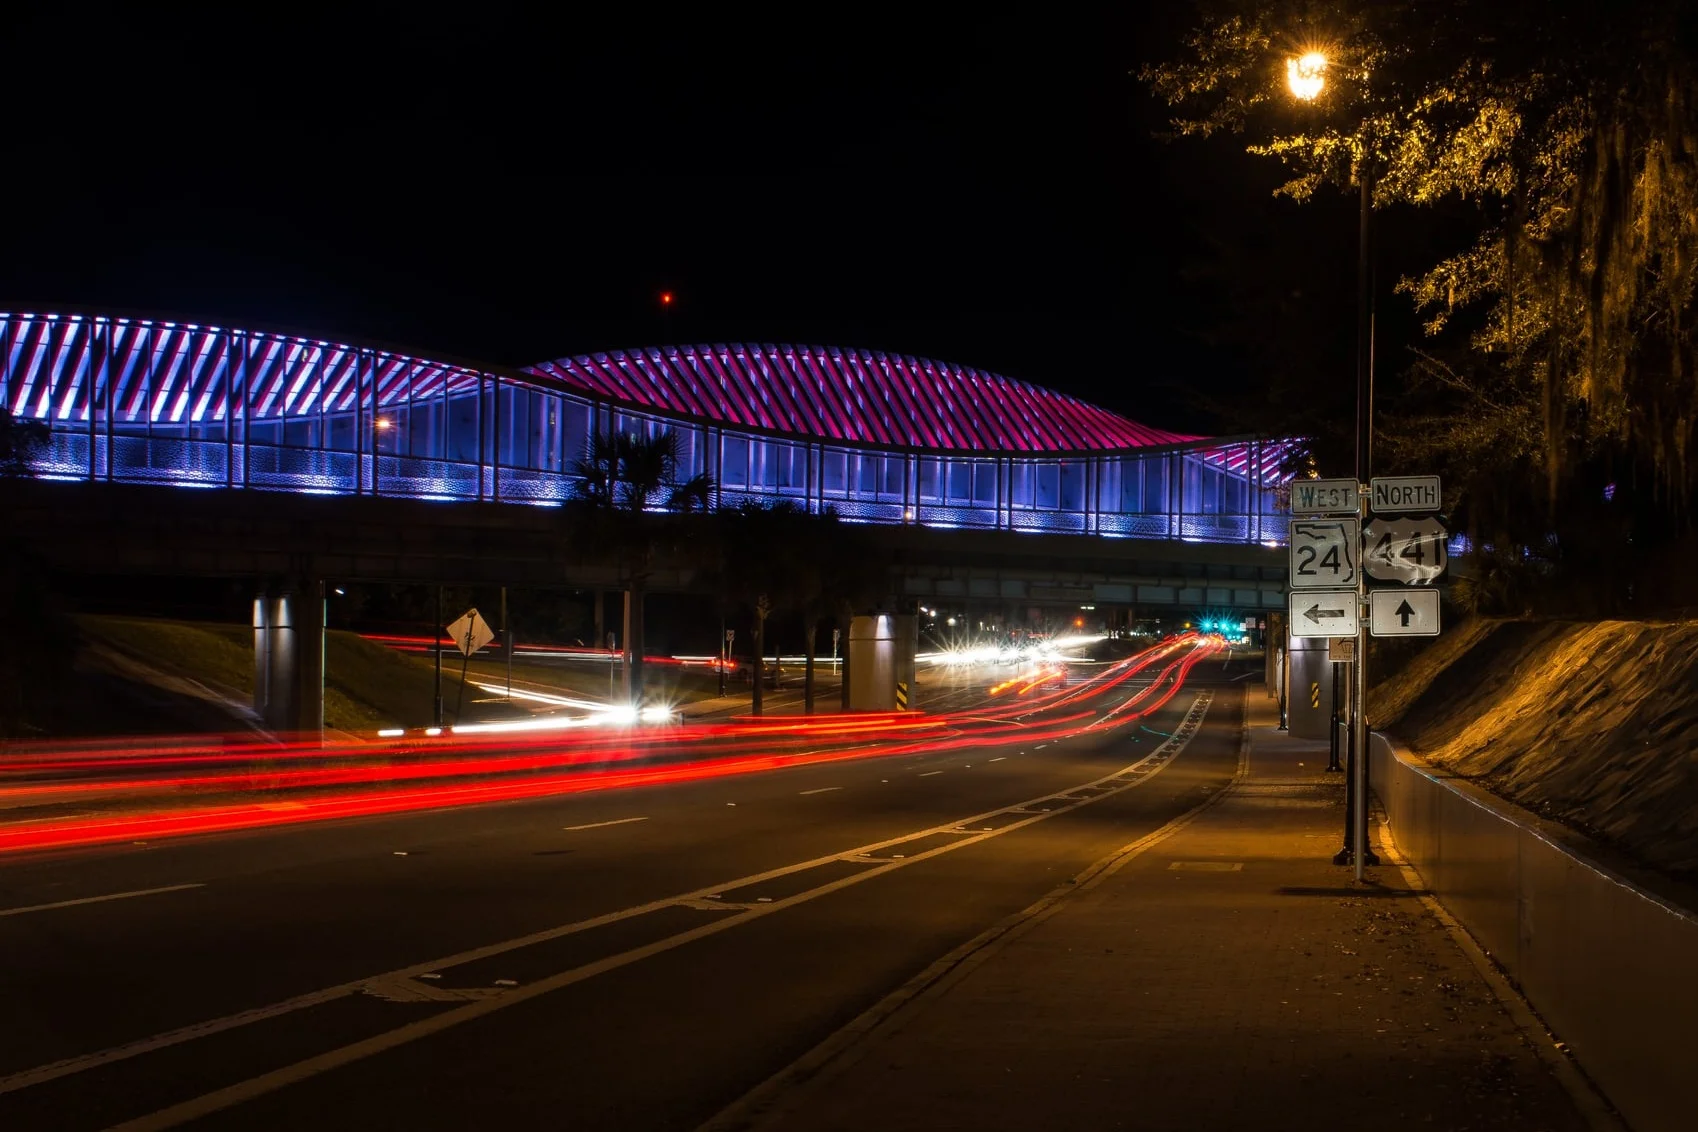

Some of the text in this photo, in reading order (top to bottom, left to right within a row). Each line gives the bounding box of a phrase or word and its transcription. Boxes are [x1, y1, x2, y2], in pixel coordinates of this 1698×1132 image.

[1300, 486, 1351, 508] WEST
[1376, 484, 1435, 505] NORTH
[1297, 545, 1341, 575] 24
[1370, 531, 1441, 567] 441
